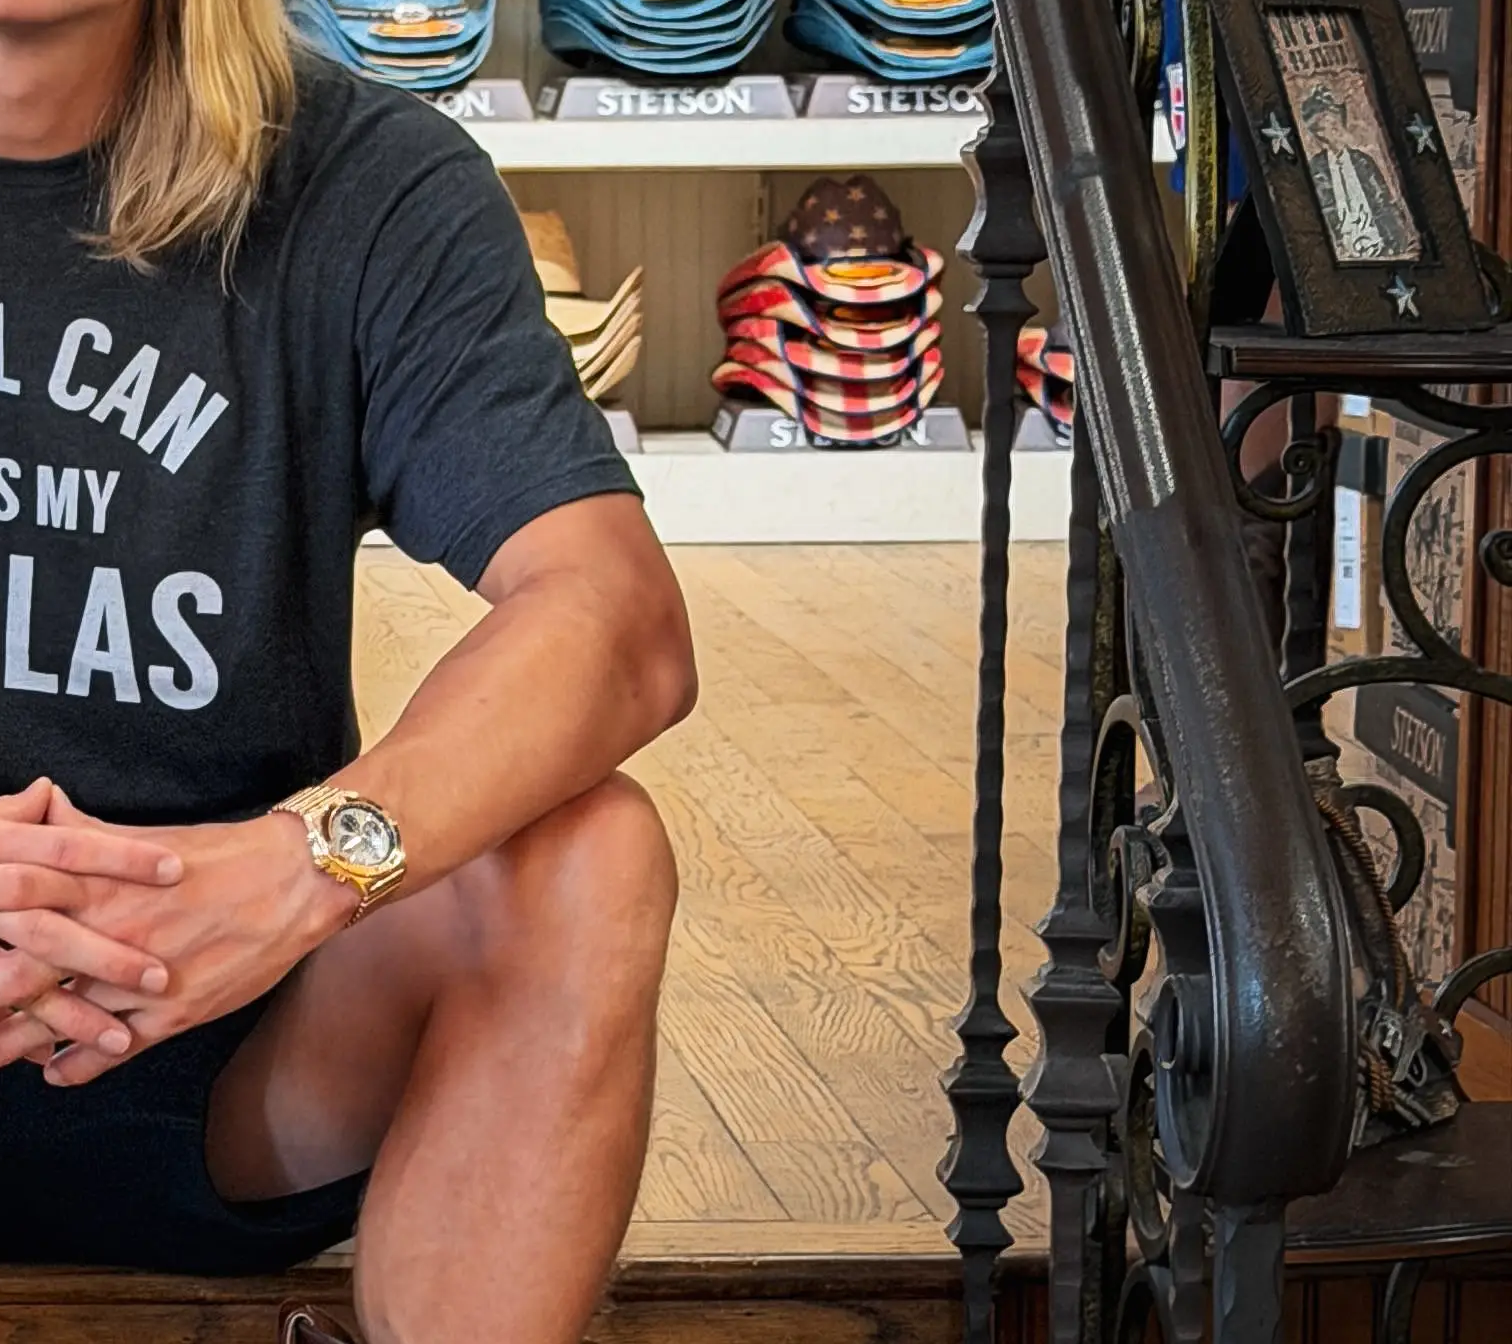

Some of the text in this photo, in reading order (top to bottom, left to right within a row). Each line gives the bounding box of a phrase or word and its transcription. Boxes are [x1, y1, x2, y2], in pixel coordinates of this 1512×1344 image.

[596, 87, 754, 116] STETSON
[48, 318, 229, 474] CAN
[36, 465, 120, 533] MY
